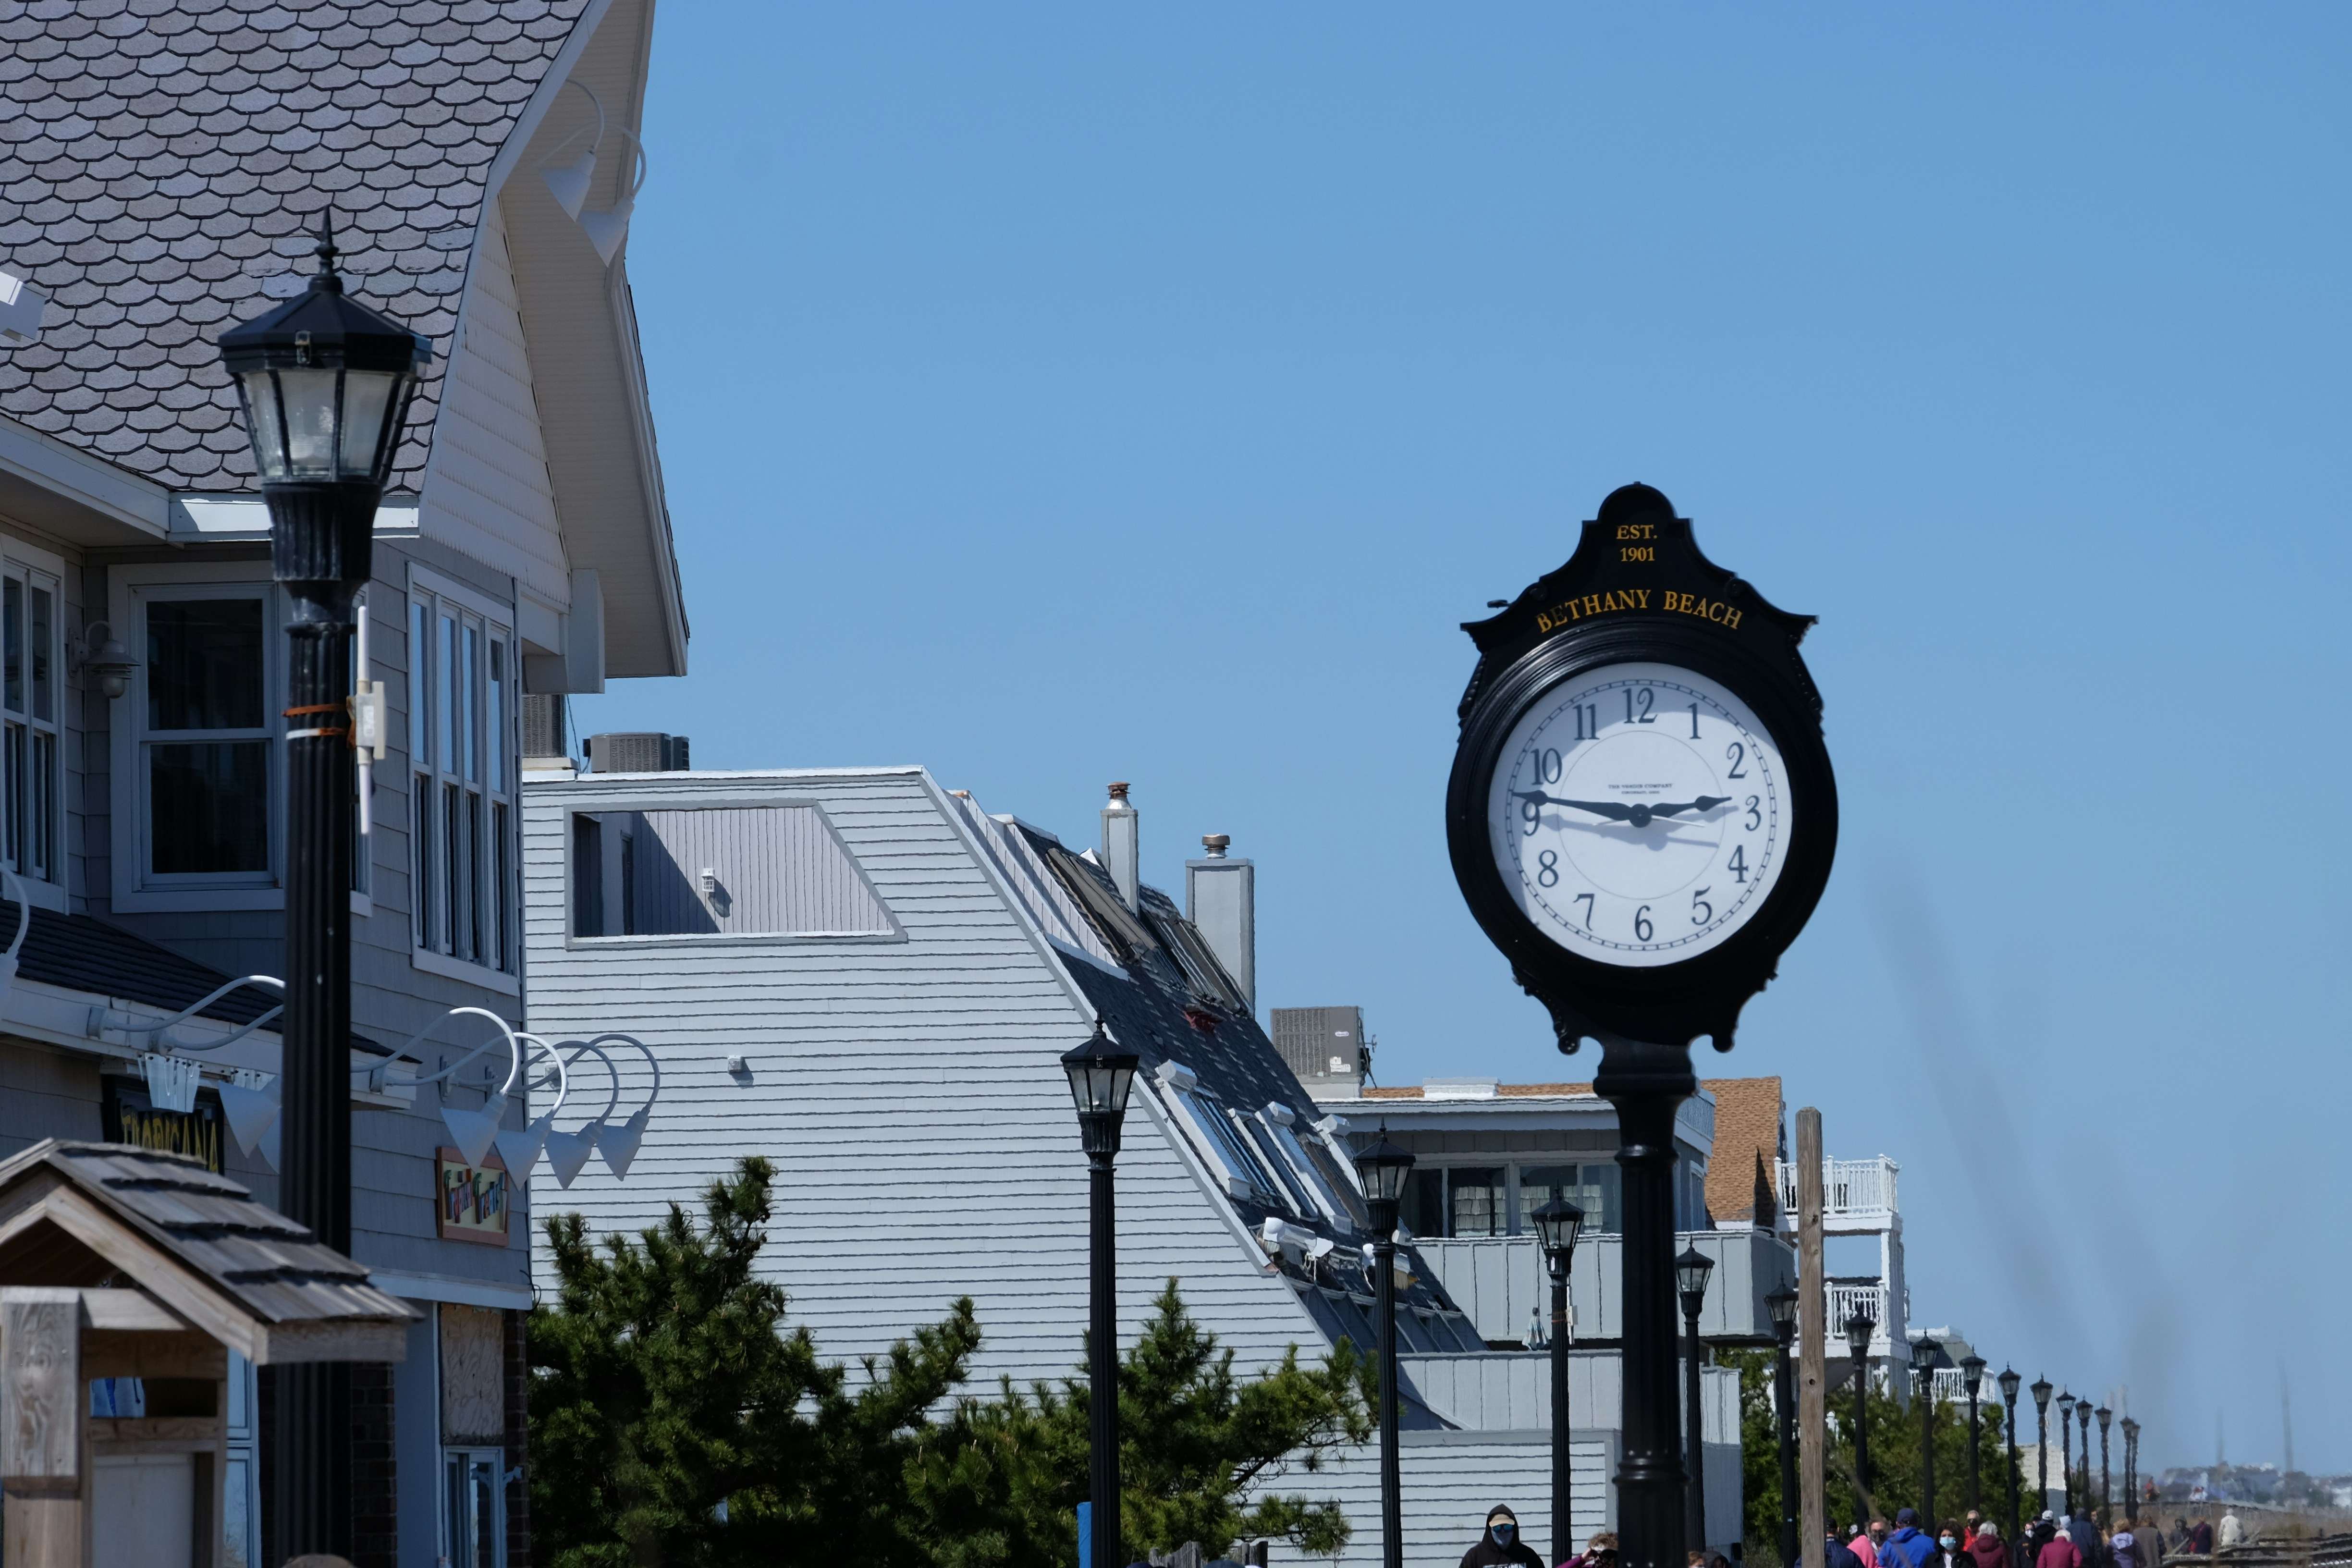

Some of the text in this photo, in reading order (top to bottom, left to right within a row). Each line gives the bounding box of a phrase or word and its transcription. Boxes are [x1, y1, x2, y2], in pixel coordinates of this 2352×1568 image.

[1617, 524, 1657, 539] EST.
[1620, 547, 1655, 562] 1901
[1536, 589, 1743, 633] BETHANY BEACH
[1573, 703, 1600, 741] 11
[1622, 687, 1658, 724] 12
[1687, 702, 1702, 739] 1
[1530, 747, 1563, 785] 10
[1726, 742, 1749, 779] 2
[1521, 799, 1541, 836] 9
[1744, 795, 1762, 832] 3
[1537, 849, 1559, 888] 8
[1727, 844, 1749, 883] 4
[1572, 893, 1595, 931] 7
[1634, 905, 1654, 942] 6
[1691, 885, 1713, 925] 5
